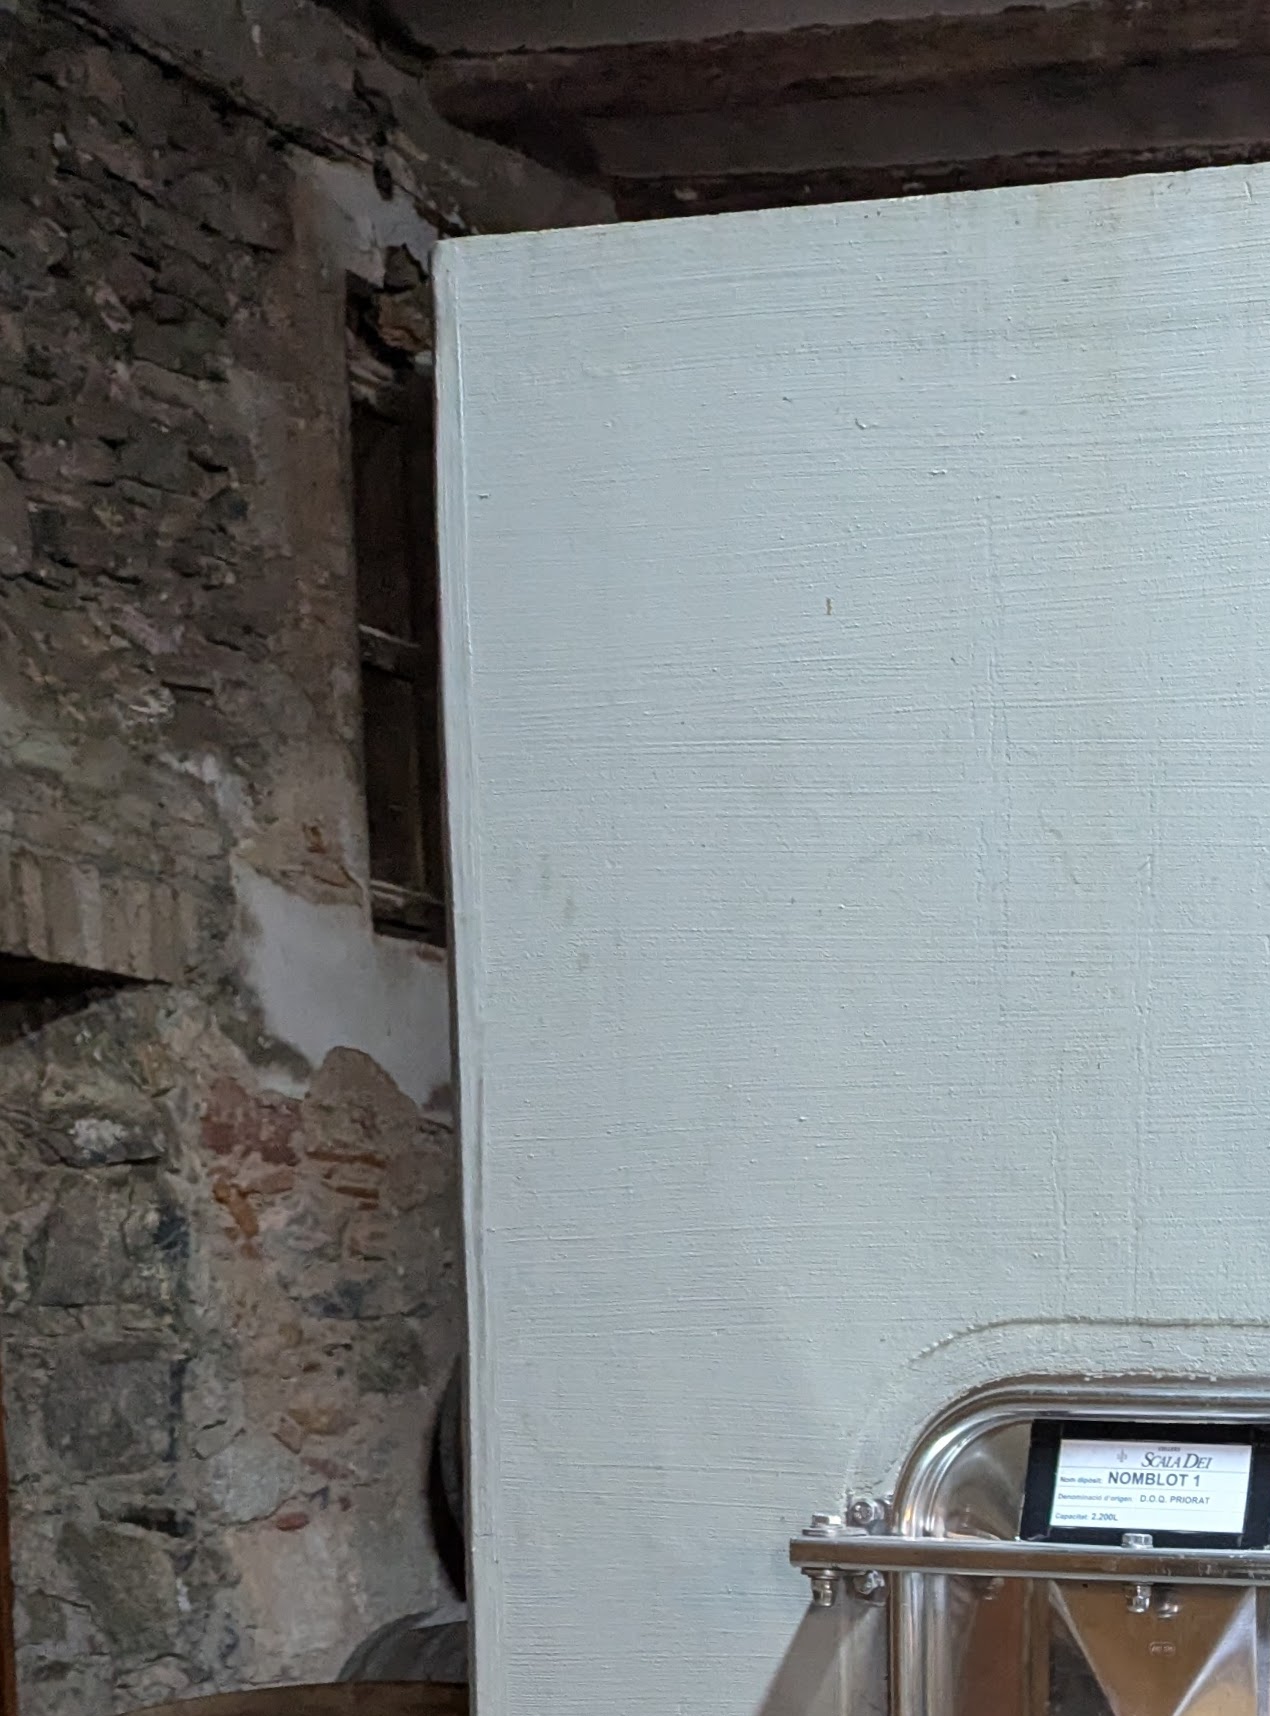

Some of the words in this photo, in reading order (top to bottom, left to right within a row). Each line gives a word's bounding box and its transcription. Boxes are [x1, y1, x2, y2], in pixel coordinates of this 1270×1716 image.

[1108, 1471, 1189, 1487] NOMBLOT
[1193, 1475, 1201, 1487] 1
[1170, 1495, 1210, 1505] PRIORAT
[1091, 1512, 1119, 1521] 2.200L
